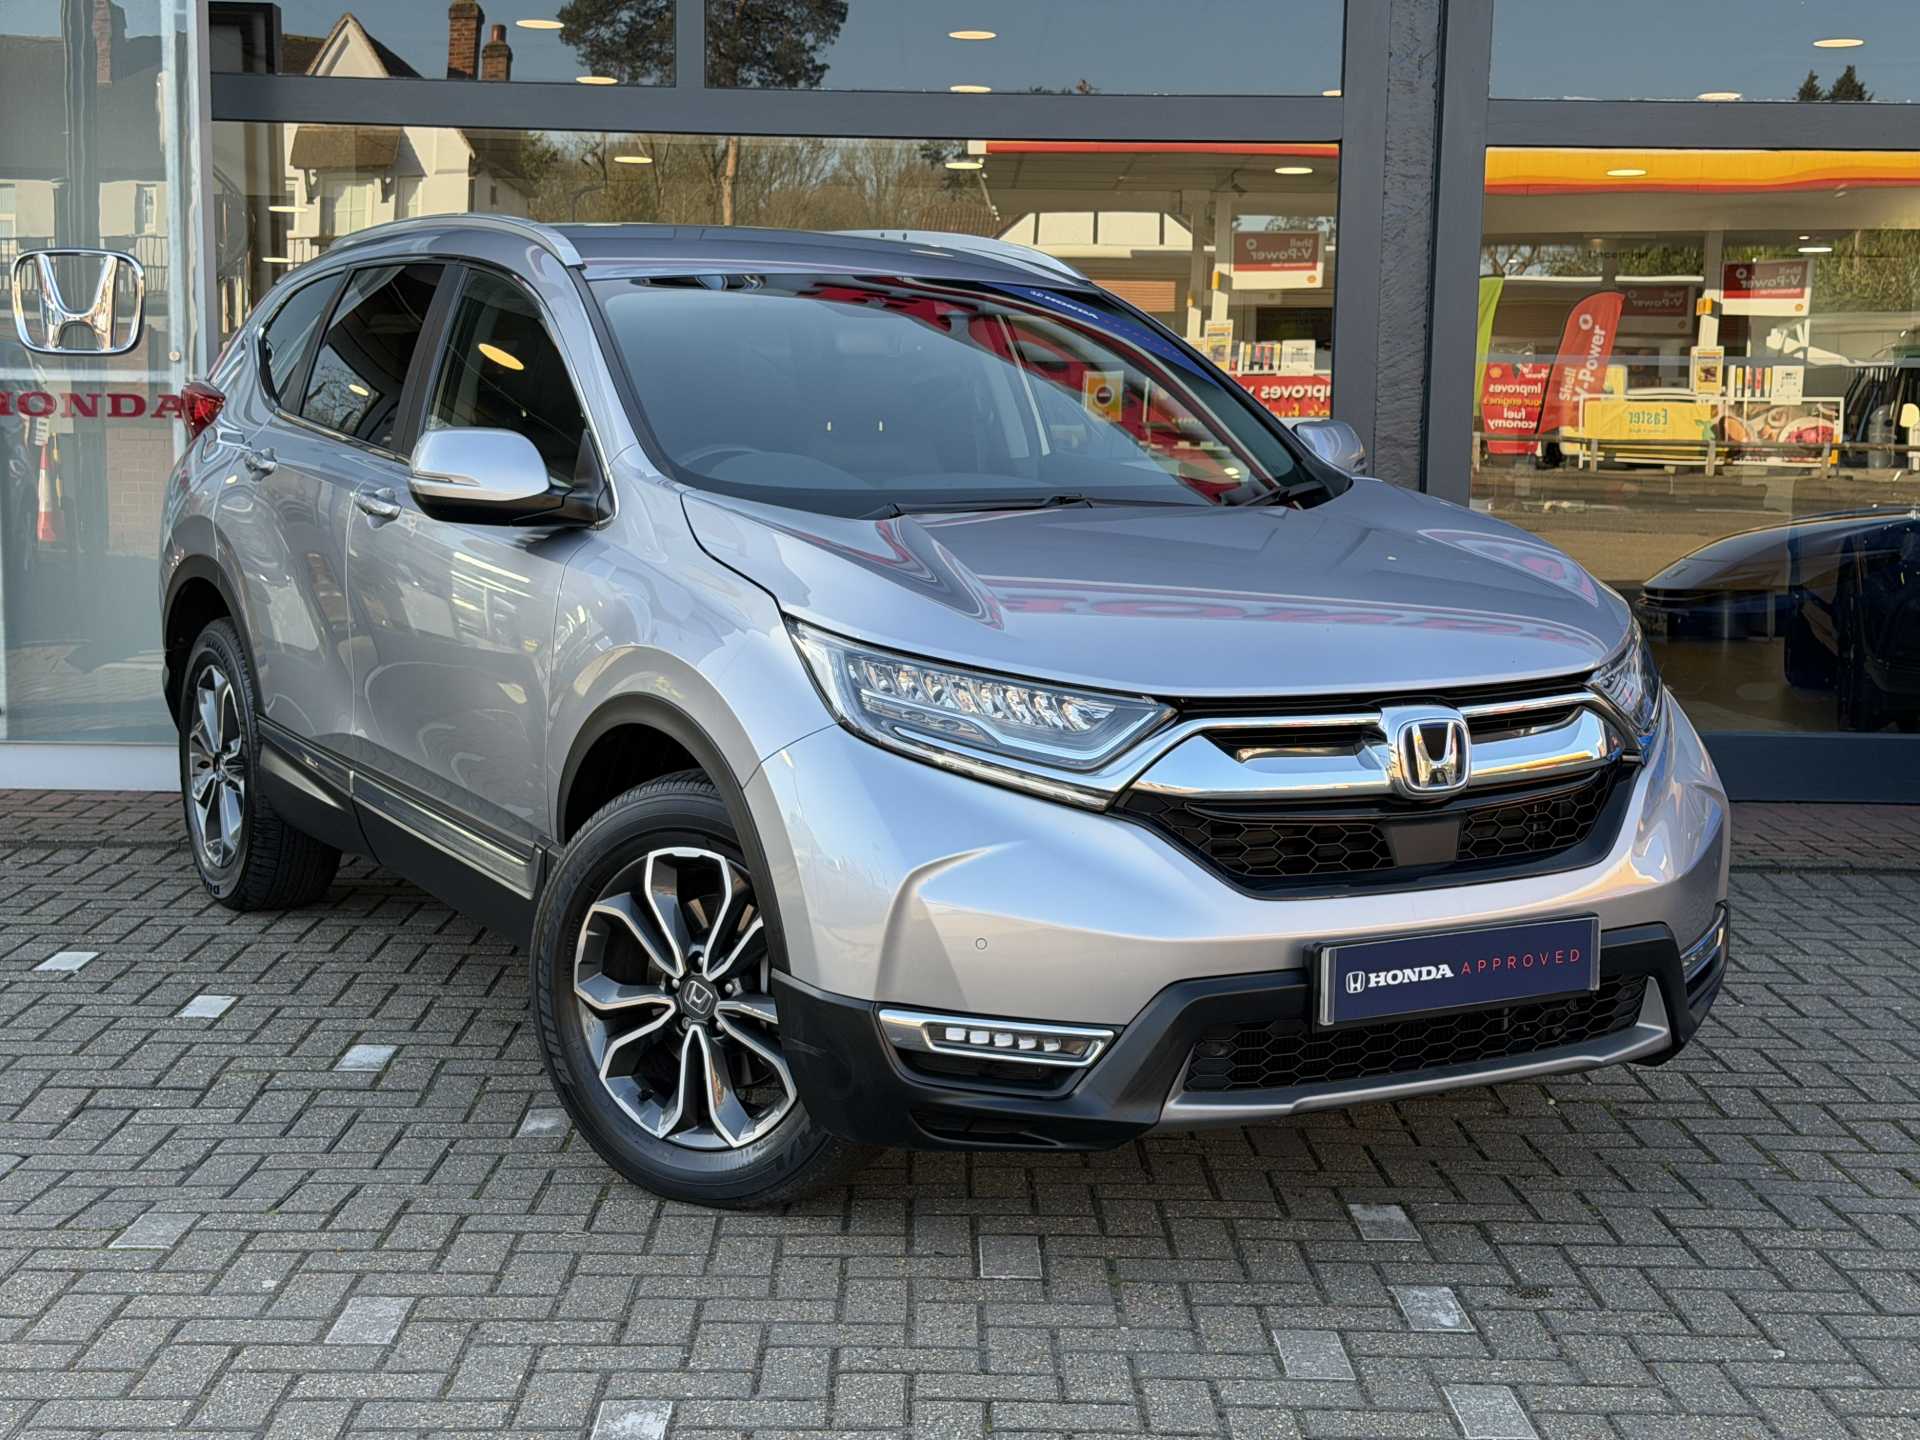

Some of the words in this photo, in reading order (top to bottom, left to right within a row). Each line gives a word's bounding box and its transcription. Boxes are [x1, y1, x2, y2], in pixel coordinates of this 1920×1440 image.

[1572, 325, 1606, 402] V-Power
[1559, 367, 1577, 401] Shell
[1368, 963, 1454, 988] HONDA
[1461, 949, 1580, 976] APPROVED
